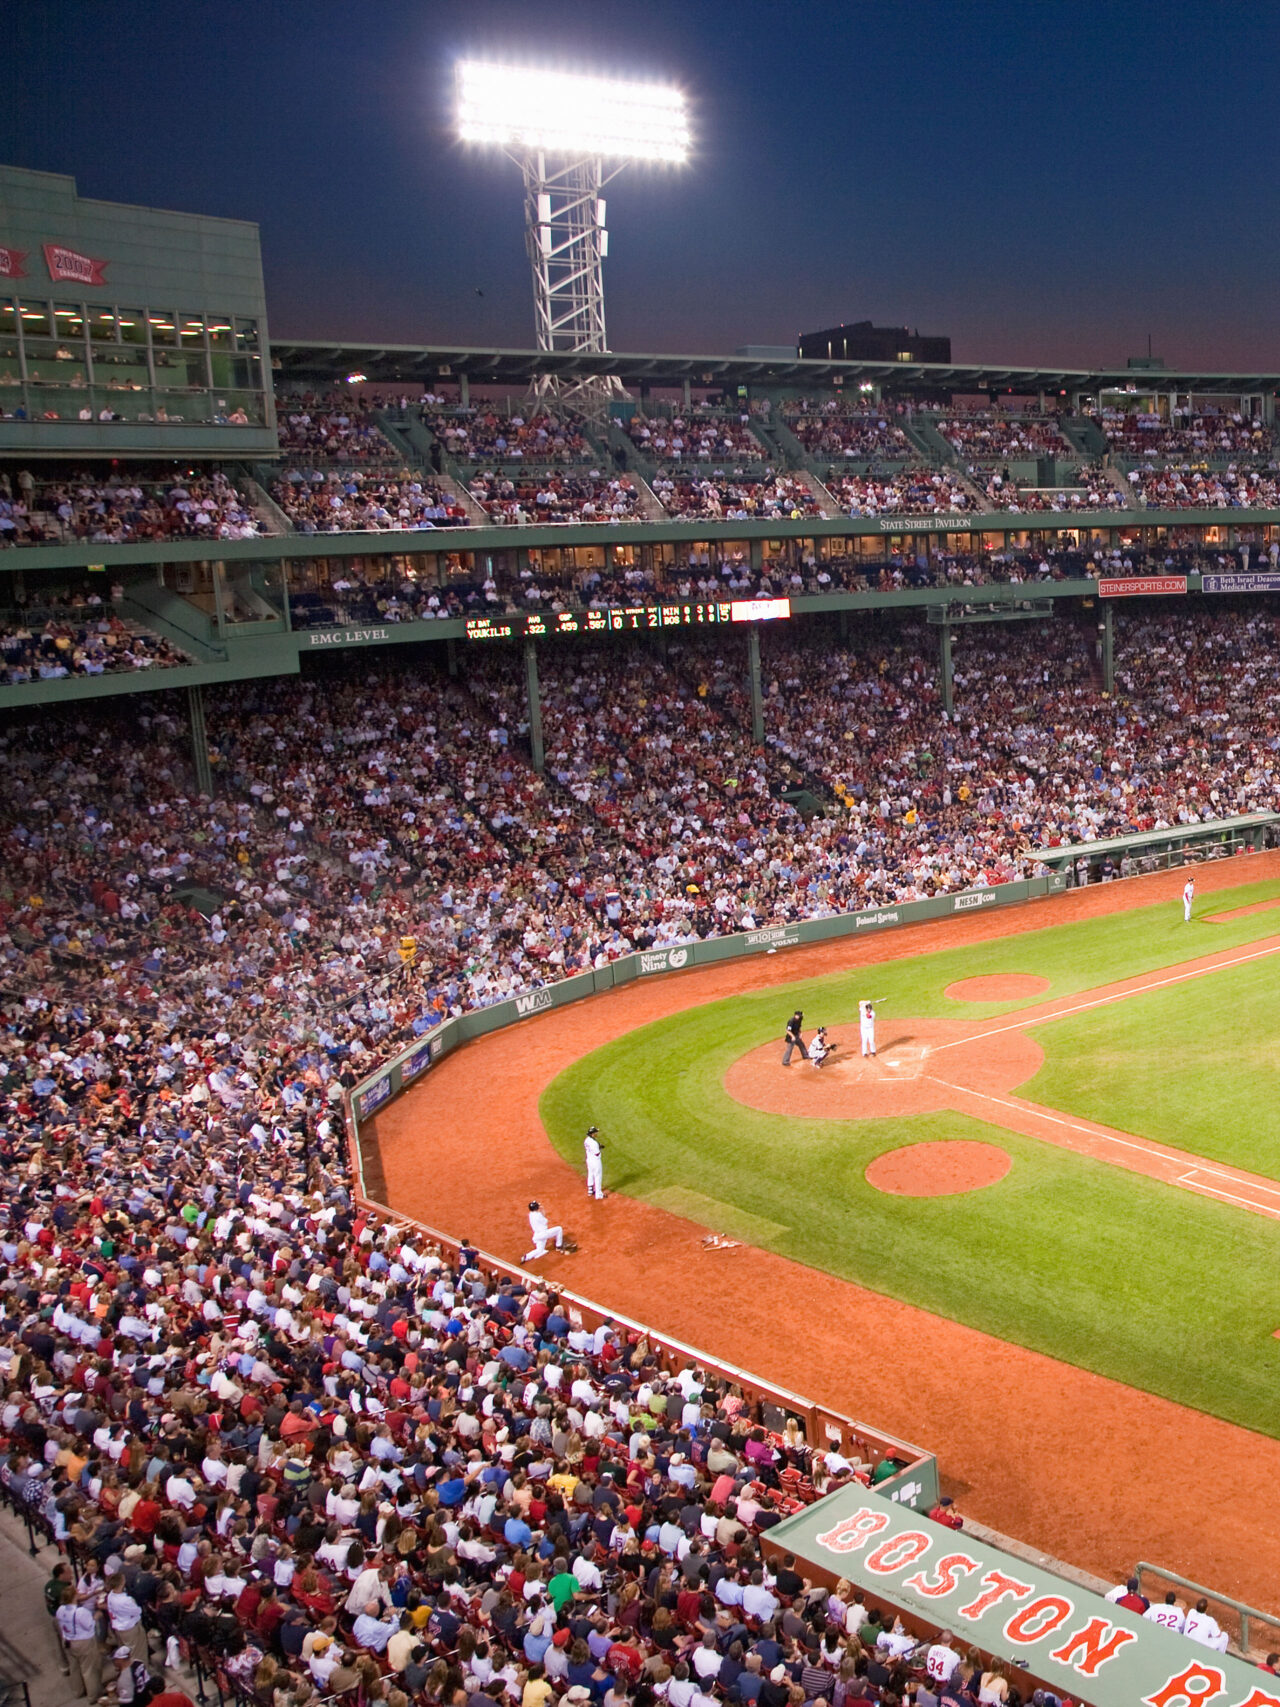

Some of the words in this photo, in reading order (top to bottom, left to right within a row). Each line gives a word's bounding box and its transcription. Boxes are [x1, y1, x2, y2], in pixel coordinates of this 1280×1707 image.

[54, 254, 93, 277] 2007
[880, 519, 904, 530] STATE
[904, 519, 932, 529] STREET
[935, 518, 971, 529] PAVILION
[1220, 576, 1235, 584] Beth
[1237, 575, 1255, 584] Israel
[1100, 581, 1185, 593] STEINERSPORTS.COM
[662, 606, 680, 616] MIN
[697, 604, 704, 614] 3
[613, 616, 623, 629] 0
[632, 615, 639, 628] 1
[648, 614, 658, 627] 2
[663, 616, 680, 625] BOS
[684, 614, 691, 623] 4
[698, 614, 704, 623] 4
[720, 611, 730, 622] 5
[467, 621, 476, 629] AT
[310, 632, 342, 645] EMC
[345, 629, 389, 642] LEVEL
[467, 626, 511, 639] YOUKILIS
[523, 624, 546, 635] .322
[958, 895, 979, 906] NESN
[855, 913, 877, 927] Poland
[878, 911, 898, 925] Spring
[772, 938, 799, 947] VOLVO
[641, 952, 667, 963] Ninety
[641, 961, 667, 972] Nine
[816, 1507, 1138, 1678] BOSTON
[1156, 1614, 1178, 1628] 22
[1189, 1621, 1199, 1634] 7
[929, 1657, 944, 1675] 34
